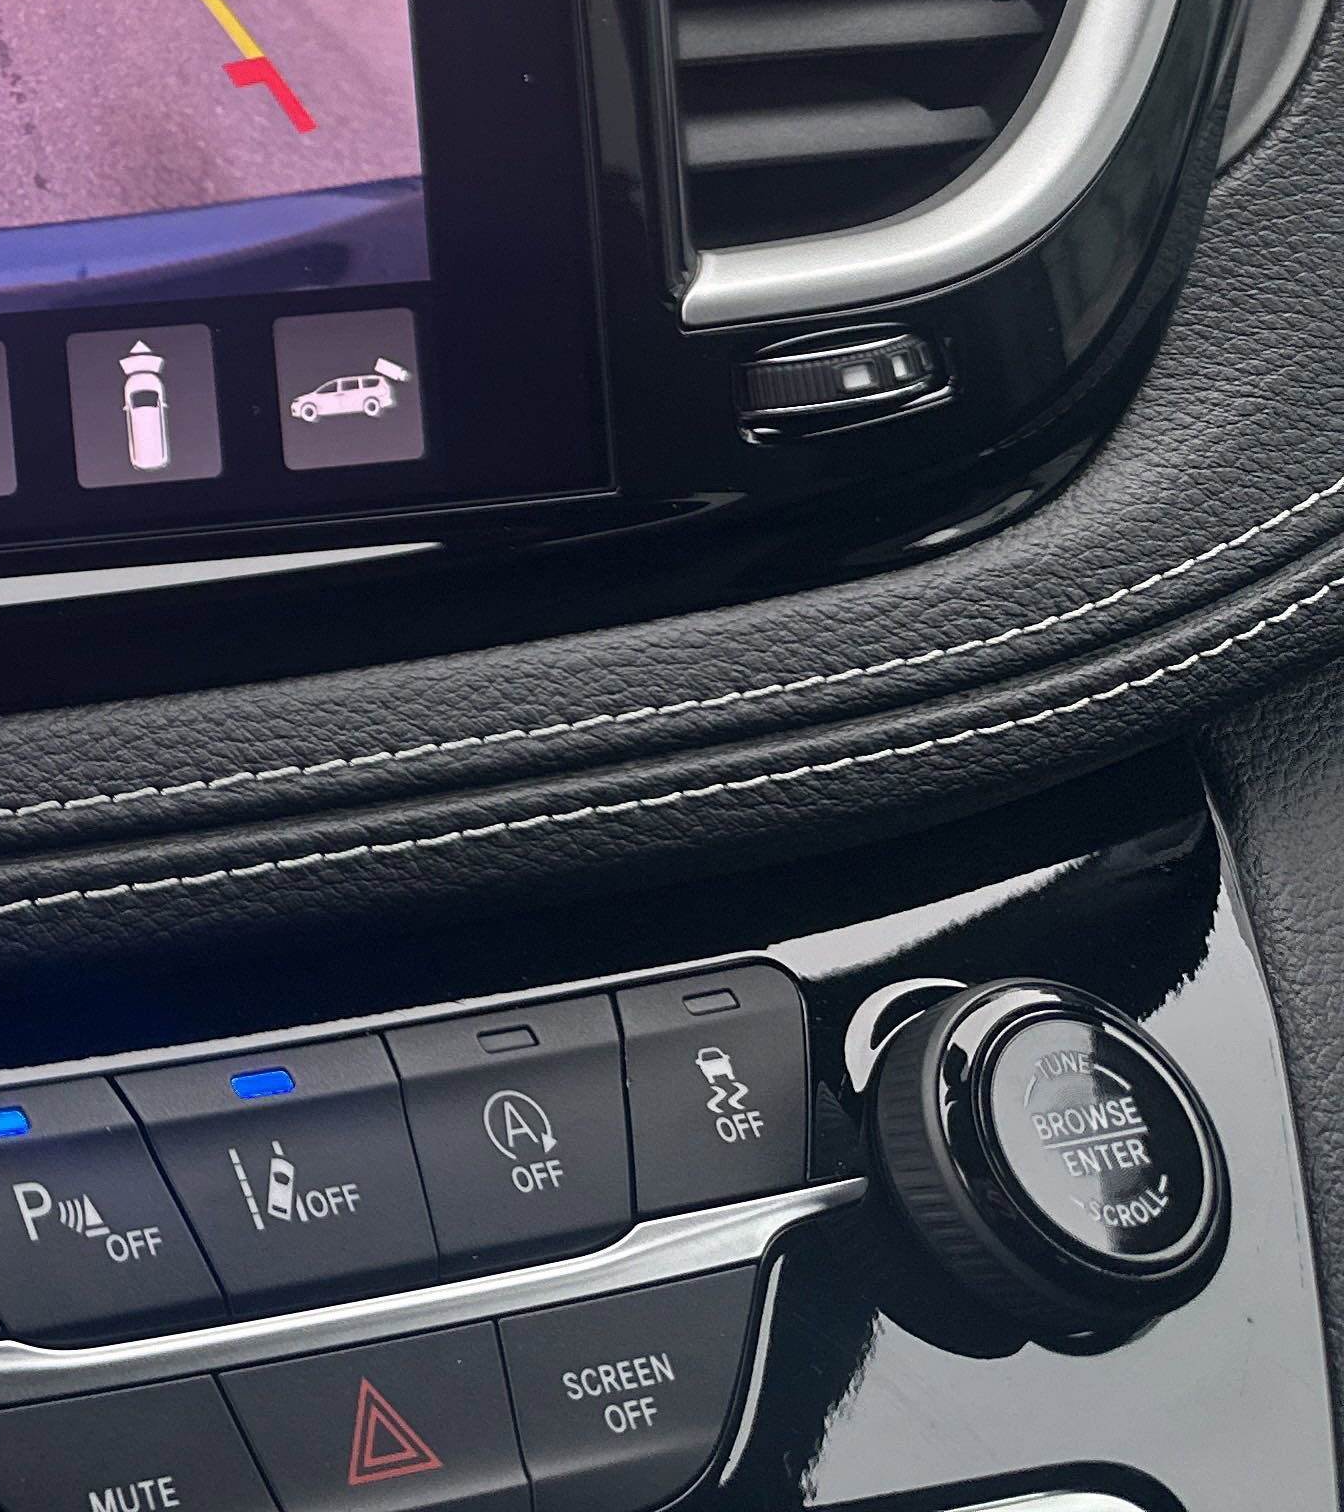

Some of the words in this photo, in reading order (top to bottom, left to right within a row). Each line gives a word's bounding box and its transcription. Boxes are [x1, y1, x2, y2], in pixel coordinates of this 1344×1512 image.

[1034, 1050, 1092, 1080] TUNE
[715, 1110, 764, 1144] OFF
[1031, 1097, 1142, 1140] BROWSE
[511, 1159, 564, 1193] OFF
[1062, 1138, 1151, 1177] ENTER
[12, 1182, 52, 1241] P
[306, 1183, 361, 1219] OFF
[1088, 1187, 1169, 1228] SCROLL
[106, 1226, 162, 1263] OFF
[562, 1352, 675, 1400] SCREEN
[604, 1396, 657, 1433] OFF
[88, 1475, 180, 1512] MUTE
